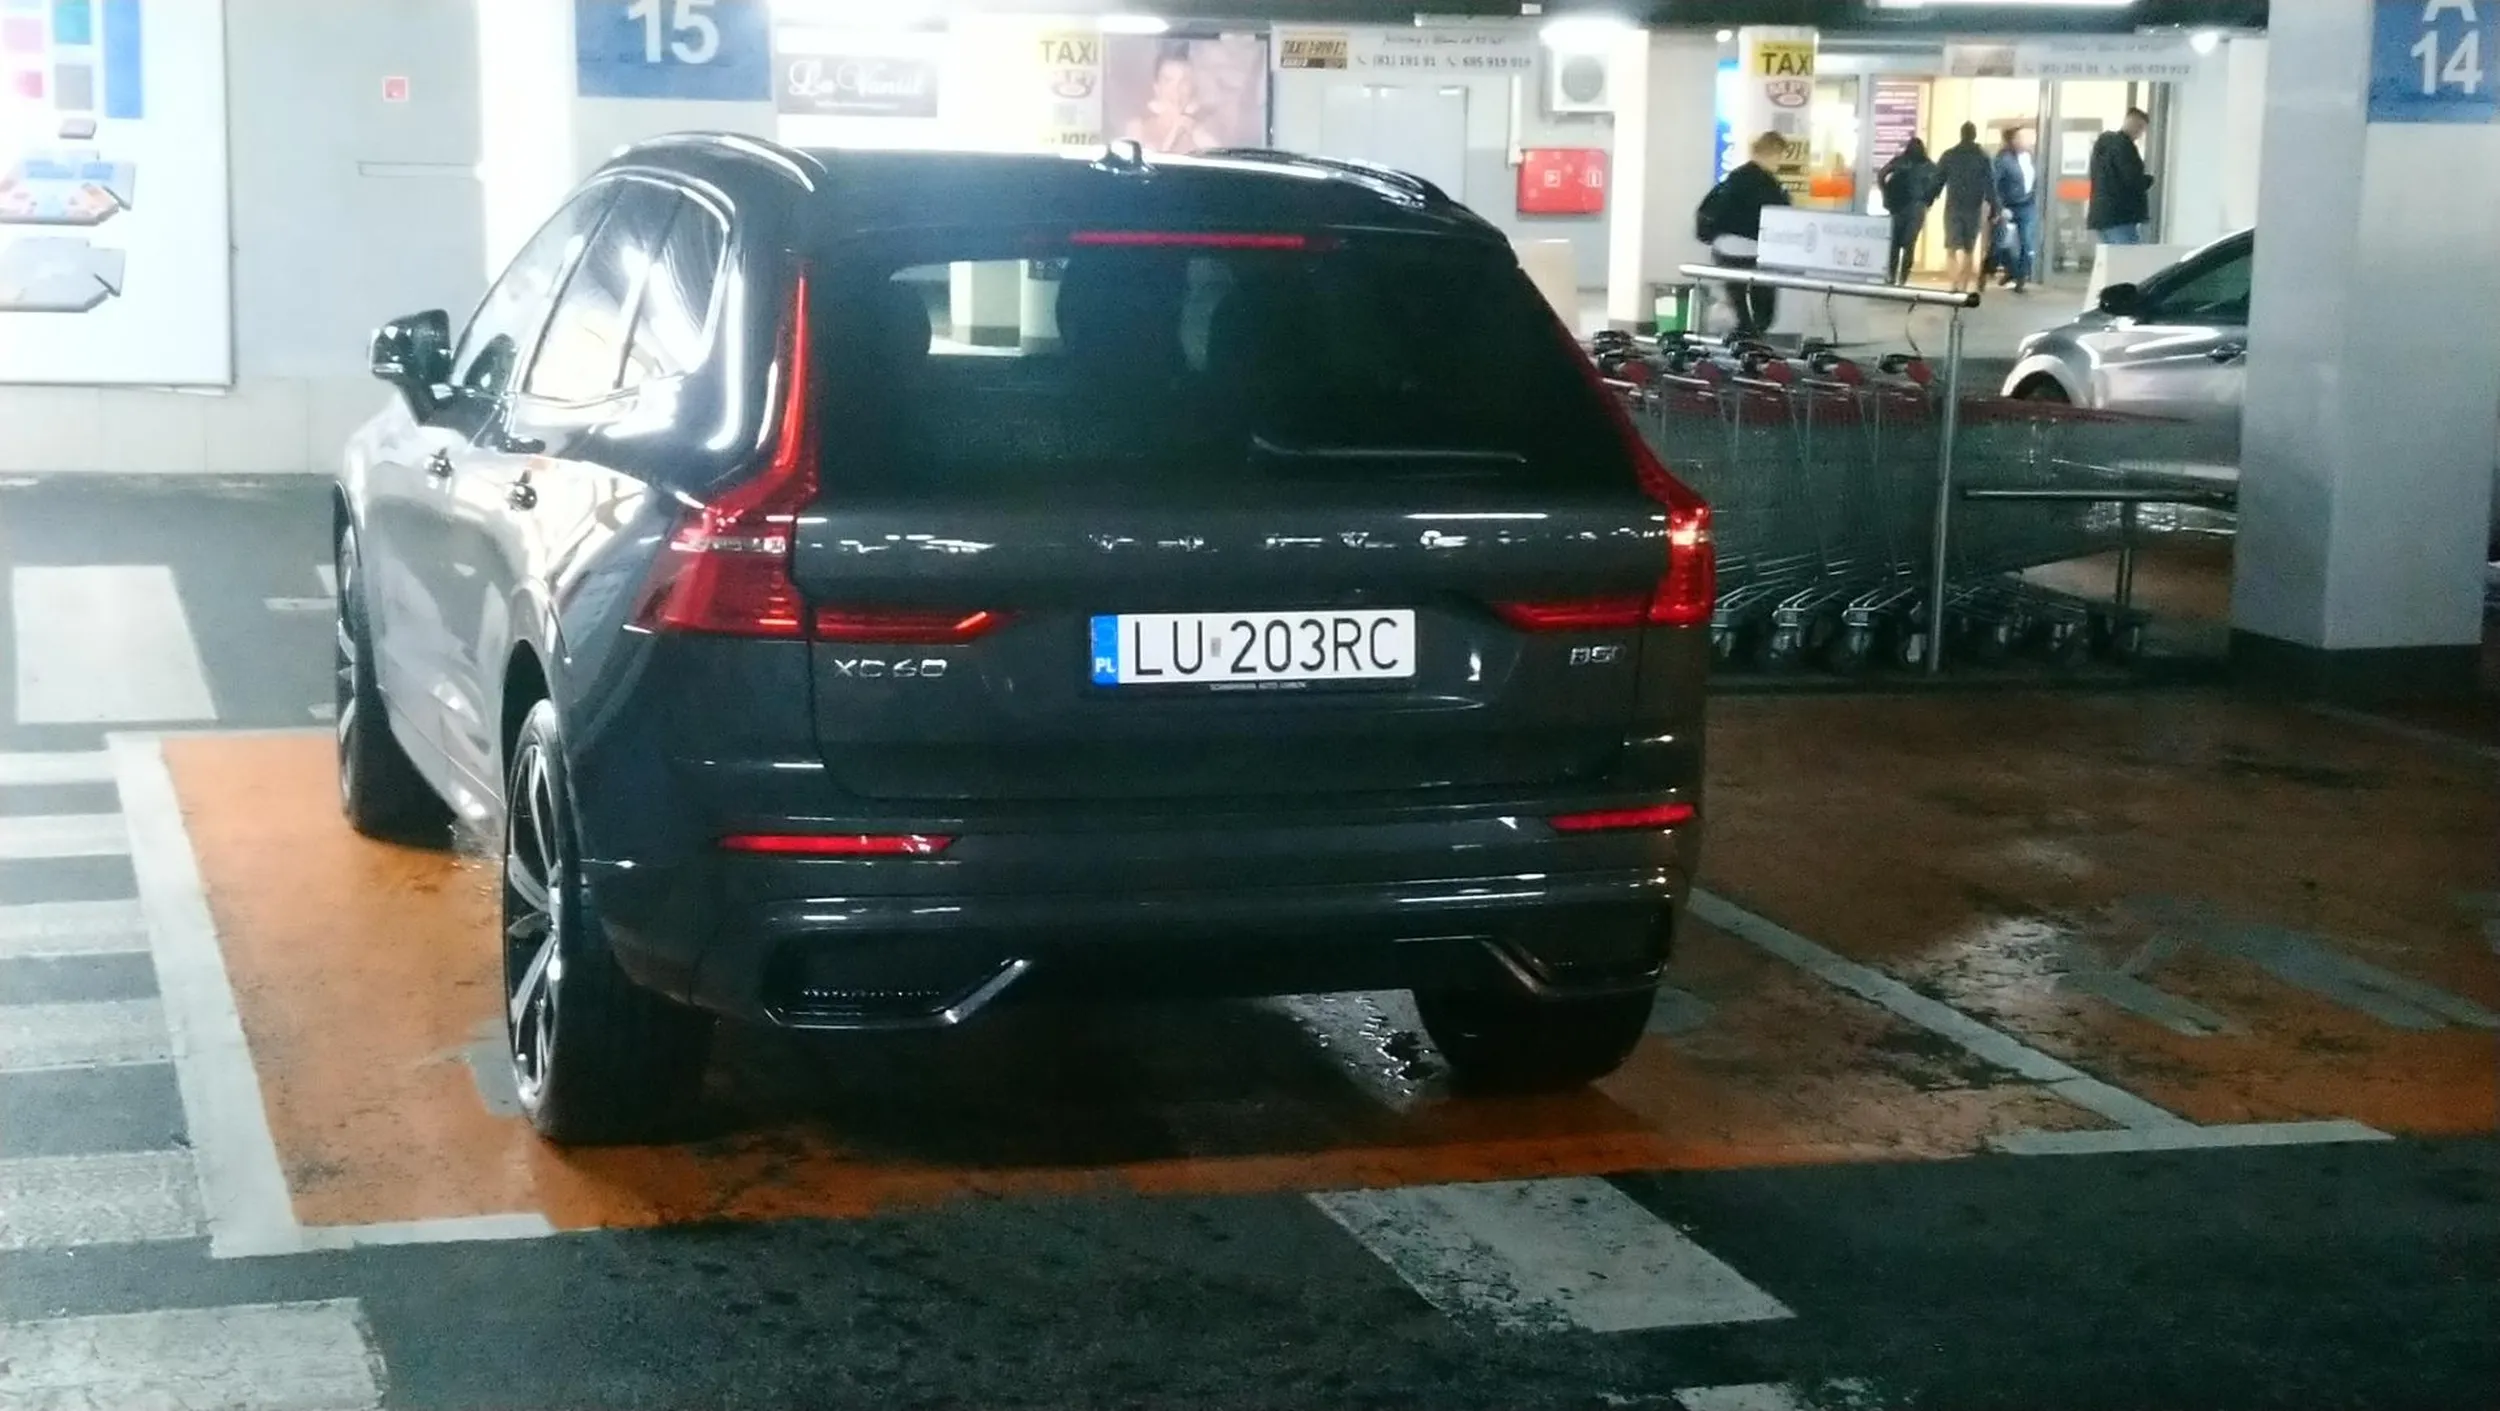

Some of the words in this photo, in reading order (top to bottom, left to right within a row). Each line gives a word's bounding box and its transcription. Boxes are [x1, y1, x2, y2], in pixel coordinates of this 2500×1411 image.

[628, 0, 719, 64] 15
[1039, 40, 1099, 65] TAXI
[2410, 29, 2482, 95] 14
[1095, 657, 1117, 674] PL
[1134, 620, 1203, 676] LU
[1229, 616, 1399, 674] 203RC
